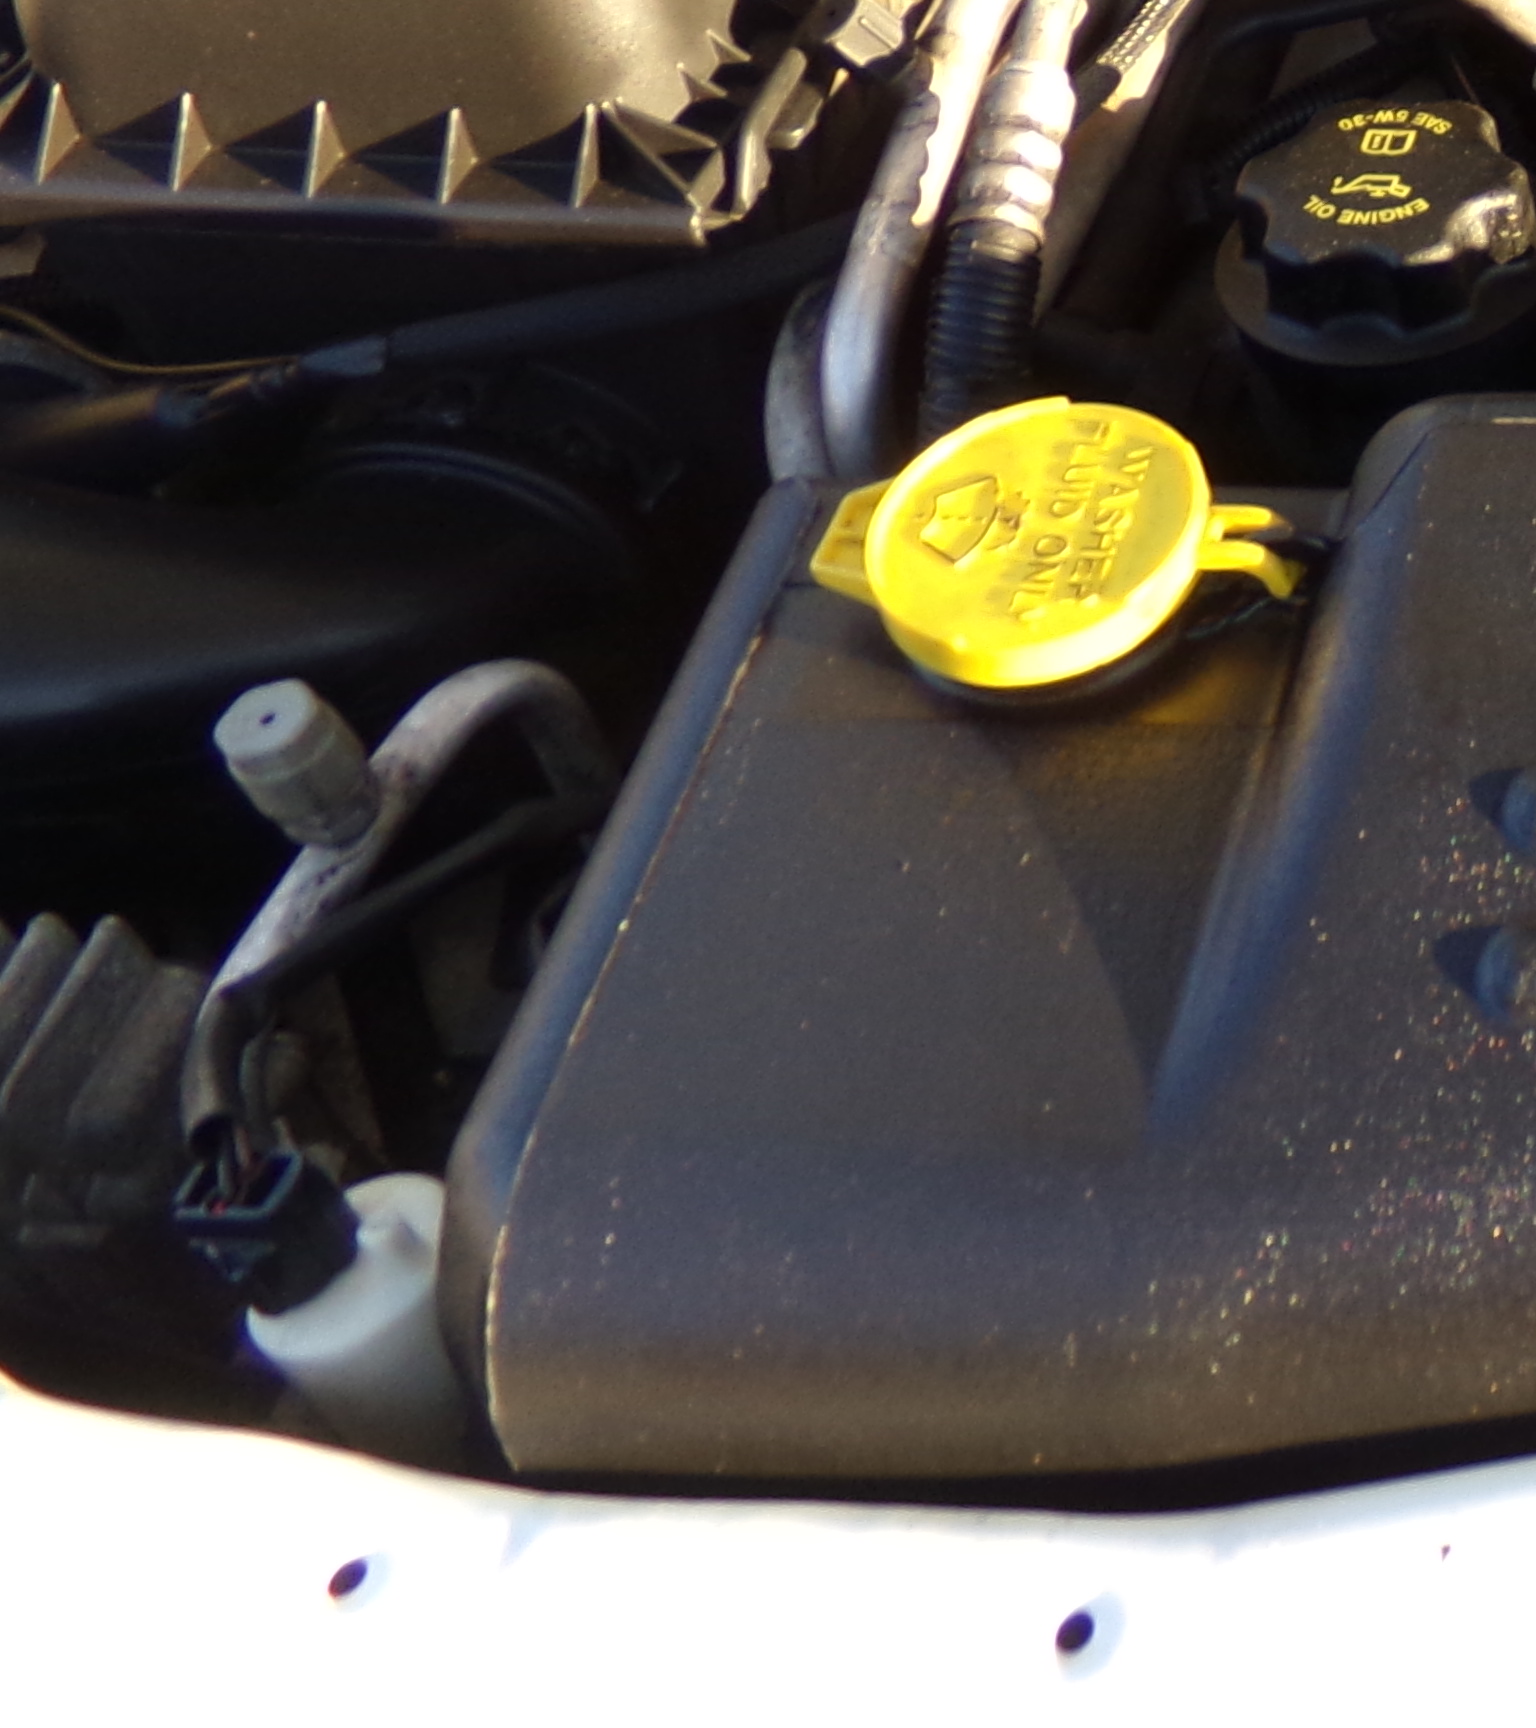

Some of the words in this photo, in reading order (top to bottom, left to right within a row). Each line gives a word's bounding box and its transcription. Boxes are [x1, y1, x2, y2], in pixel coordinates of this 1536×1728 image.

[1338, 108, 1411, 133] 5W-30
[1413, 111, 1454, 136] SAE
[1302, 193, 1336, 220] OIL
[1336, 196, 1431, 226] ENGINE
